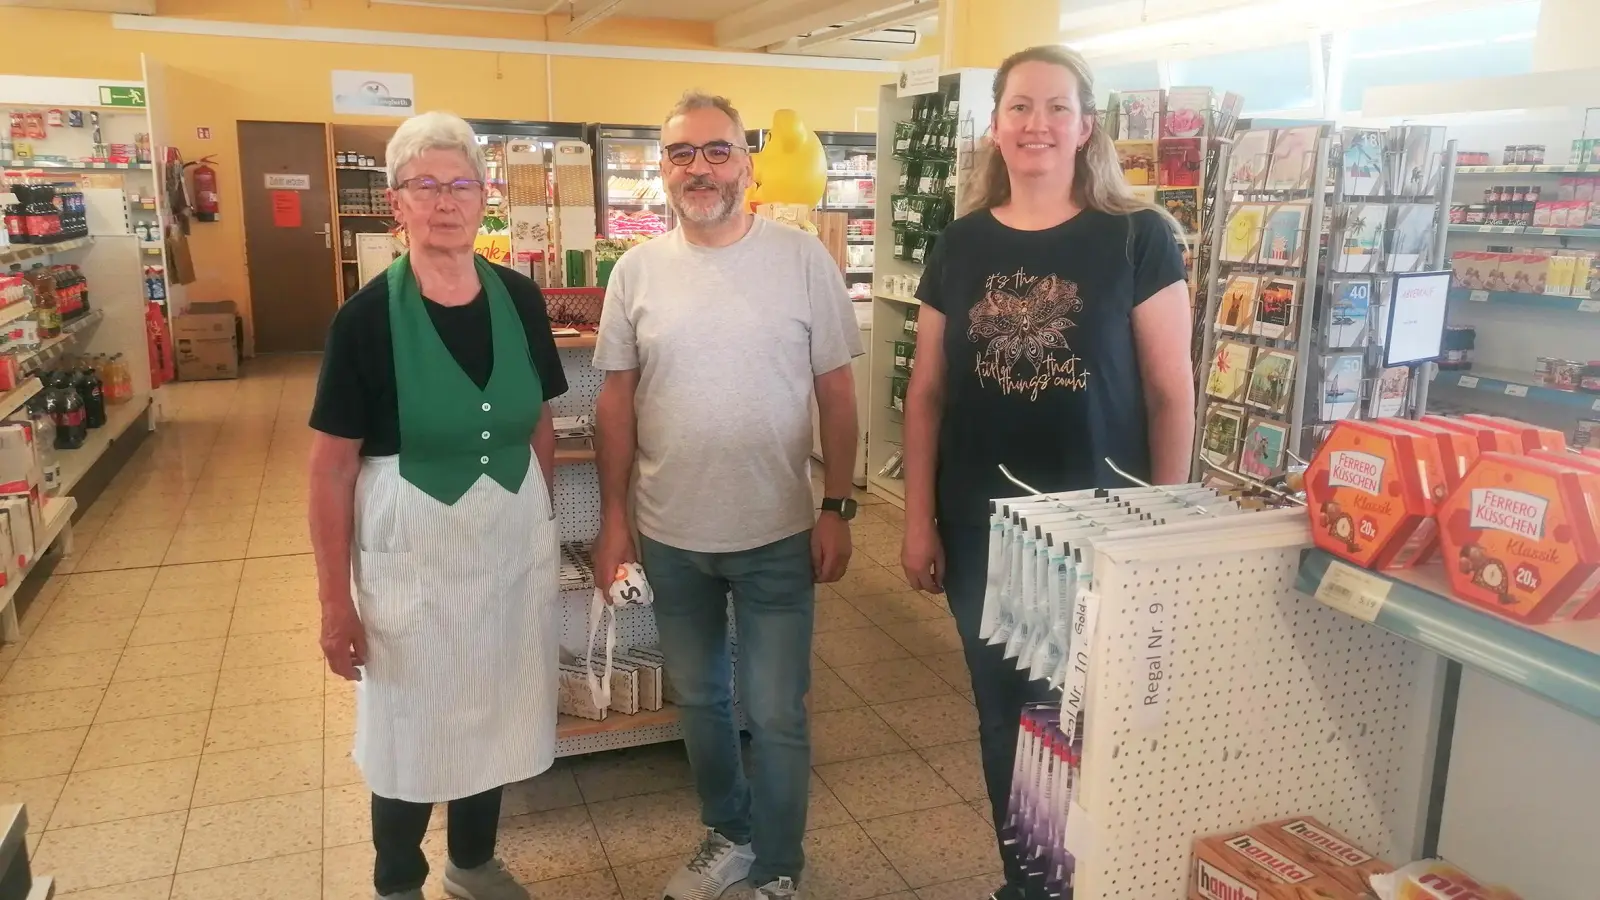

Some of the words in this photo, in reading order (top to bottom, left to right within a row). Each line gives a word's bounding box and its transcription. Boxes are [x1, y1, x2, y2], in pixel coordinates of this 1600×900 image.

[1011, 266, 1039, 289] the
[1349, 285, 1367, 299] 40
[1042, 352, 1082, 377] that
[1343, 359, 1360, 372] 50
[999, 373, 1052, 401] things
[1053, 368, 1091, 392] count
[1338, 452, 1377, 476] FERRERO
[1353, 494, 1392, 516] Klassik
[1483, 490, 1538, 519] FERRERO
[1360, 519, 1376, 538] 20x
[1506, 538, 1560, 565] Klassik
[1516, 567, 1538, 589] 20x
[1148, 602, 1165, 615] 9
[1147, 620, 1164, 649] Nr.
[1143, 655, 1164, 706] Regal
